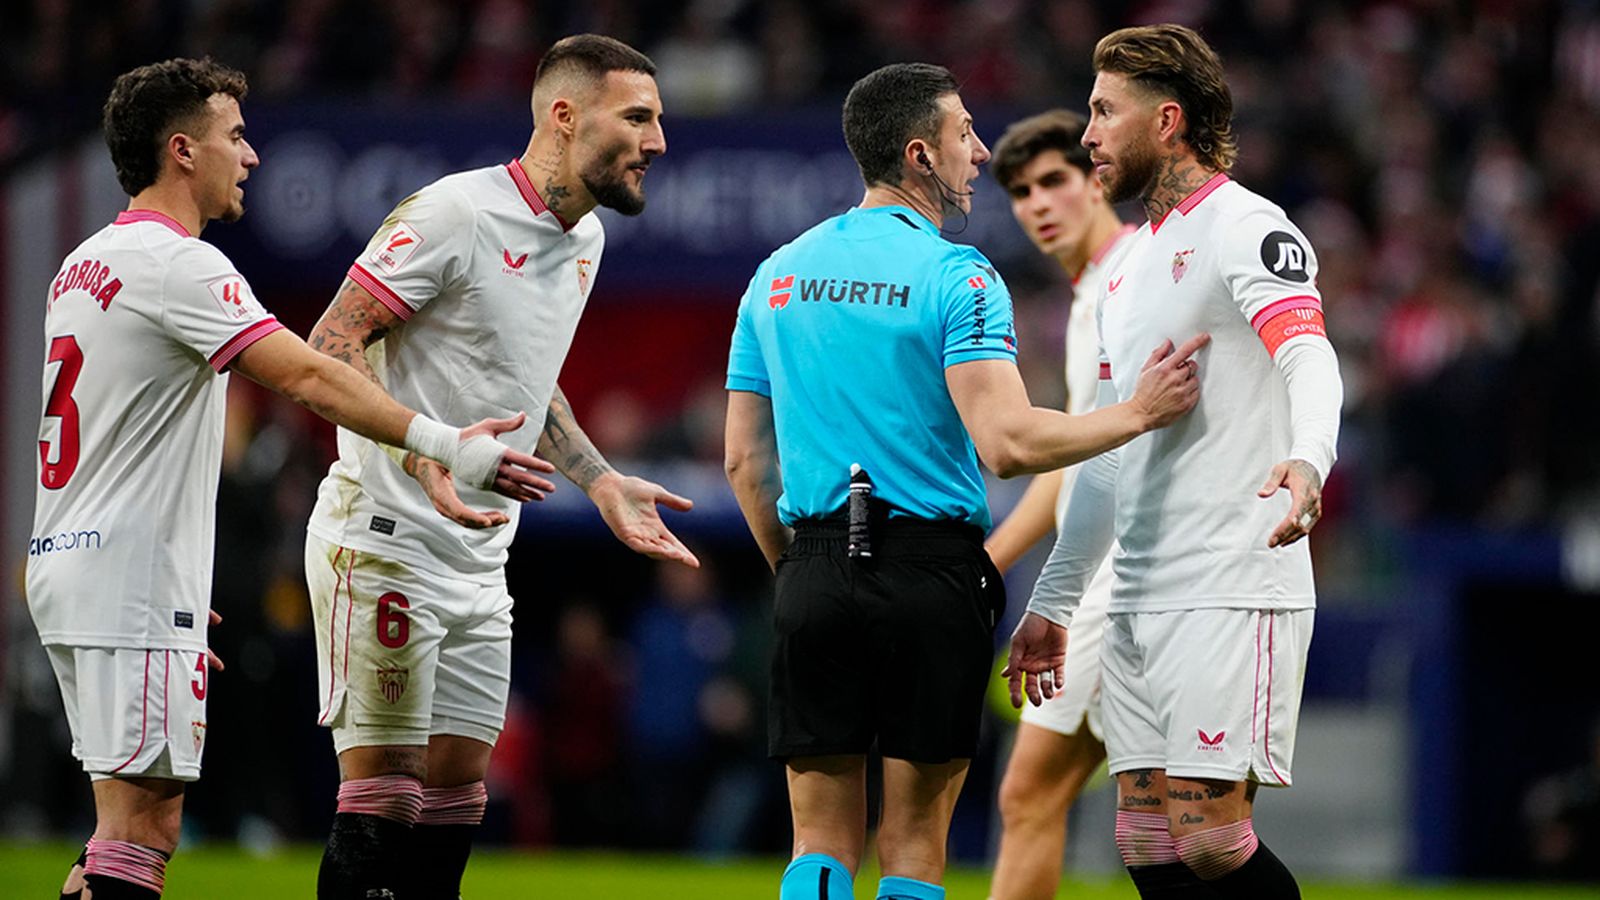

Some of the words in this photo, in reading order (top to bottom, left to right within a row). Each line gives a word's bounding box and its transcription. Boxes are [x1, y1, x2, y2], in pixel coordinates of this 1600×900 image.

[1273, 242, 1303, 272] JD
[47, 260, 123, 312] EDROSA
[38, 334, 84, 490] 3
[377, 591, 410, 649] 6
